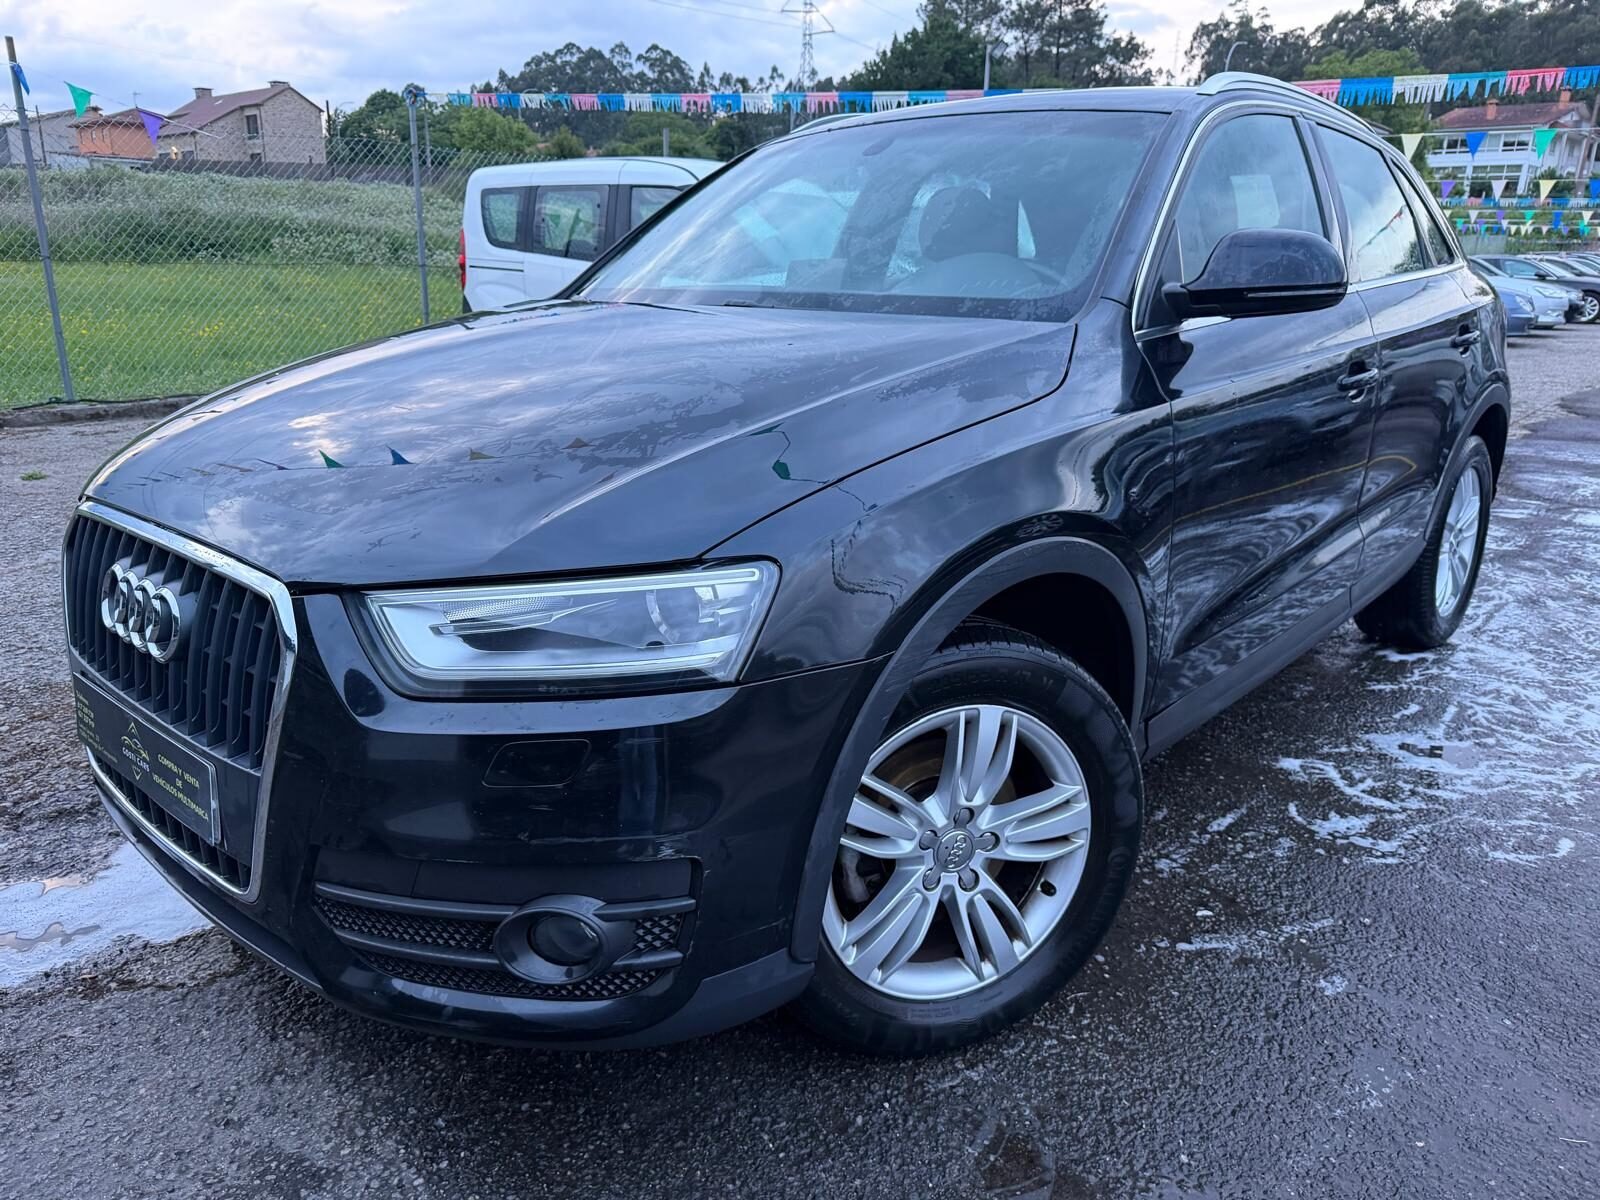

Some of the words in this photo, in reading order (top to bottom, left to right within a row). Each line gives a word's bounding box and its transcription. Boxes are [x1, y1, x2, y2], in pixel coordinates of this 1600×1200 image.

[137, 757, 150, 772] CARS
[158, 754, 178, 775] COMPRA
[183, 771, 200, 789] VENTA
[175, 777, 183, 789] DE
[177, 790, 209, 821] MULTIMARCA
